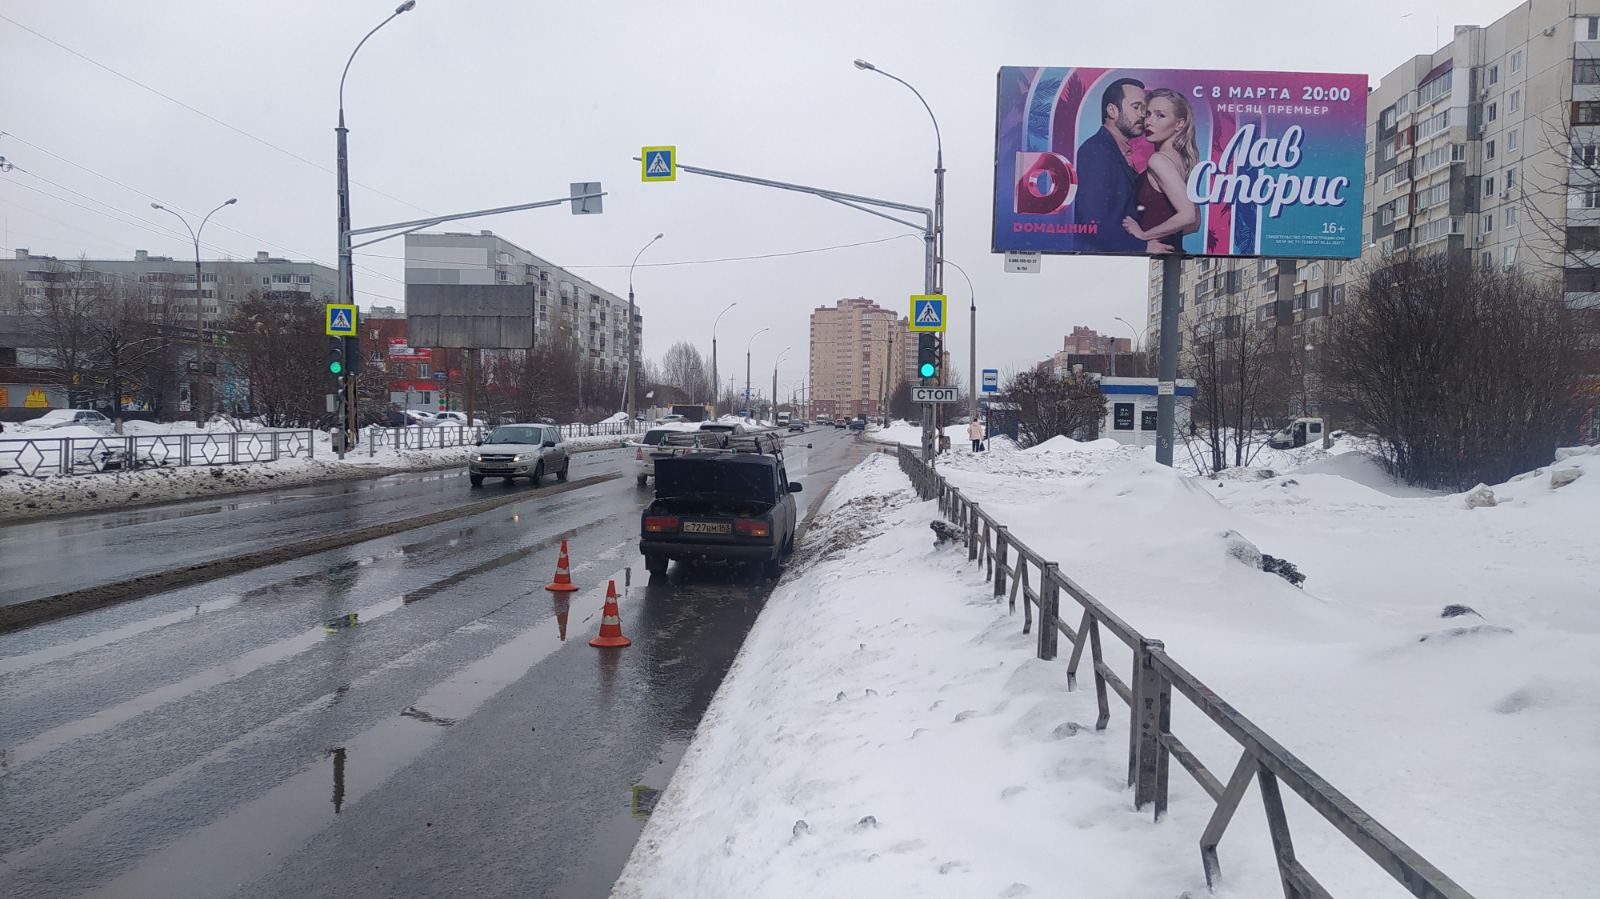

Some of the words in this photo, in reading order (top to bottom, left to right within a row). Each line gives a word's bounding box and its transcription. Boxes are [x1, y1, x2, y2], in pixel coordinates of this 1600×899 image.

[1192, 85, 1203, 98] С
[1211, 86, 1221, 98] 8
[1229, 86, 1291, 100] МАРТА
[1302, 86, 1351, 101] 20:00
[1217, 103, 1263, 115] МЕСЯЦ
[1268, 104, 1329, 115] ПРЕМЬЕР
[1218, 123, 1304, 173] Лав
[1186, 160, 1349, 218] Сторис
[1322, 222, 1345, 234] 16+
[917, 389, 953, 400] СТОП
